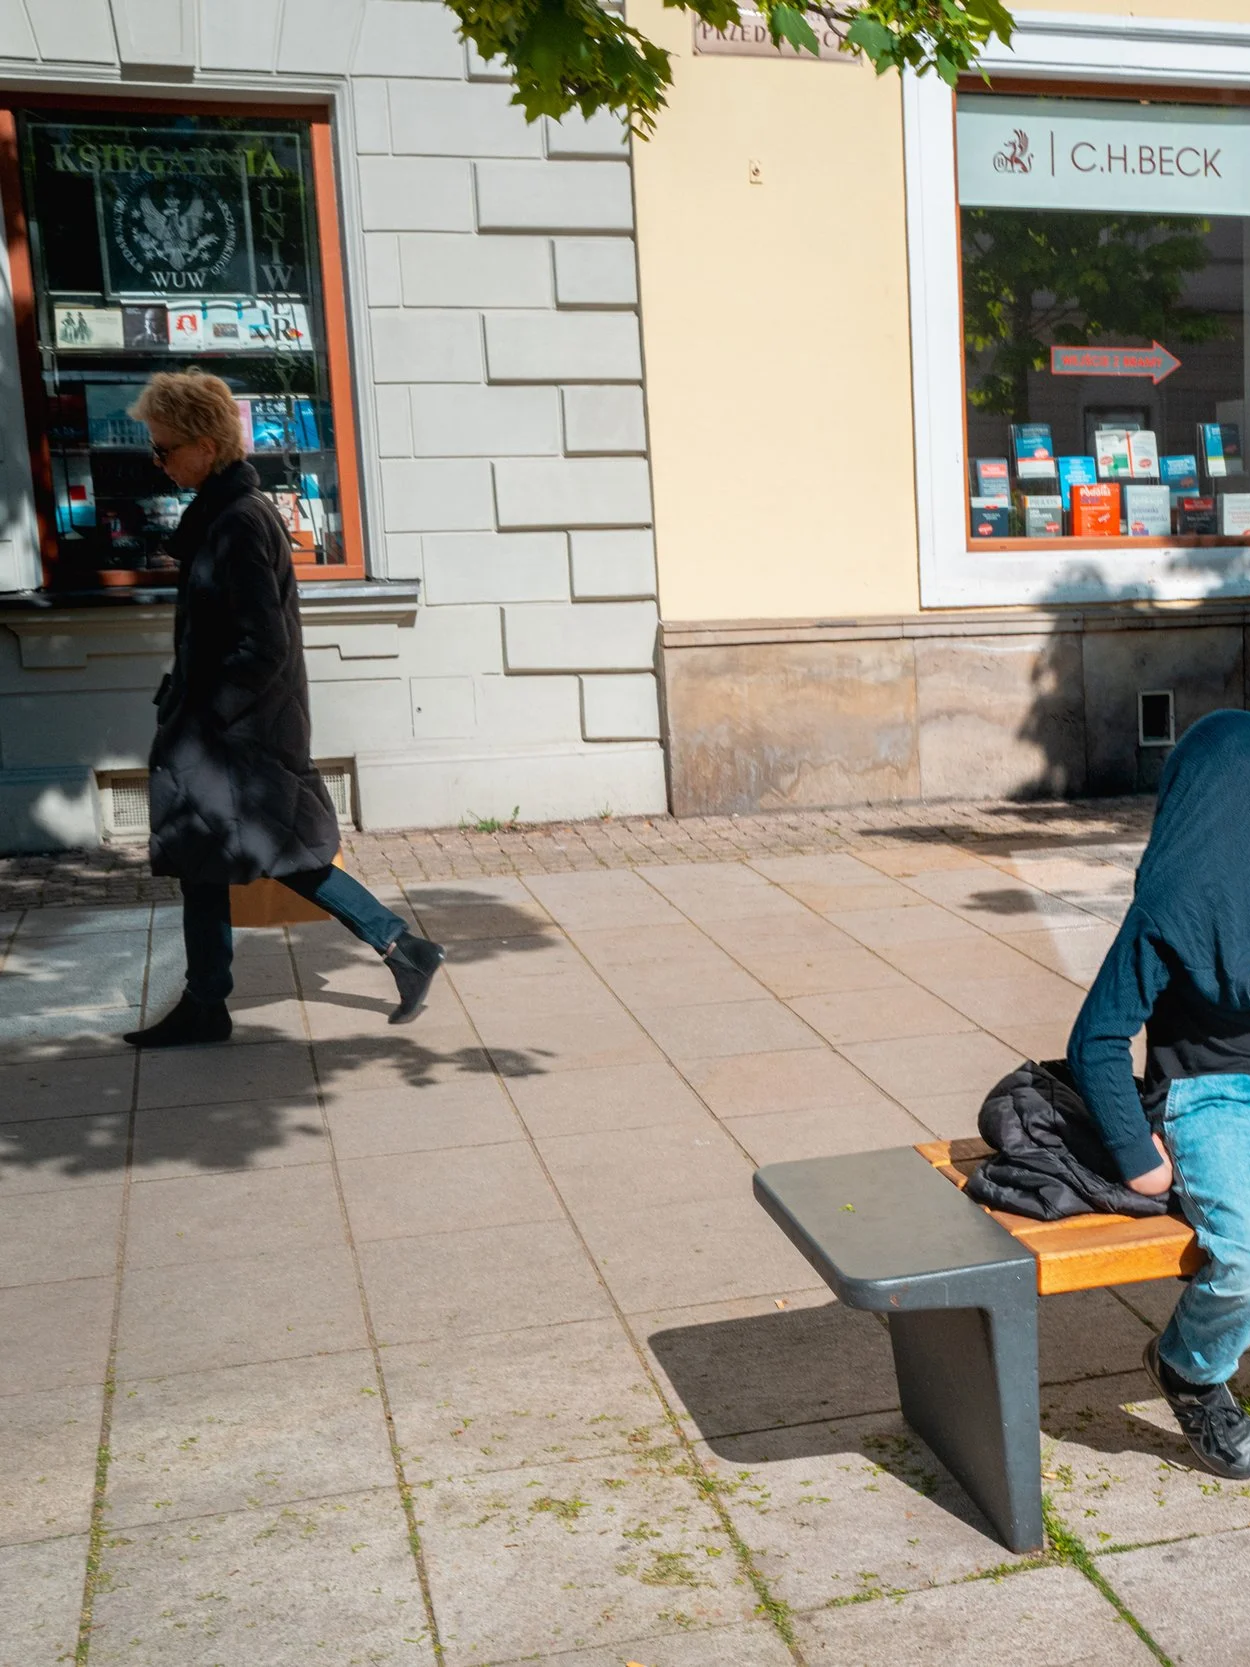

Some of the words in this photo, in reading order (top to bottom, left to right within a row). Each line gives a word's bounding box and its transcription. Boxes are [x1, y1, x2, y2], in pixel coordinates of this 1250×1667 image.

[1070, 141, 1222, 178] C.H.BECK
[150, 271, 207, 289] WUW
[1062, 353, 1109, 368] WEJŚCIE
[1112, 355, 1120, 368] Z
[1123, 355, 1163, 369] BRAMY
